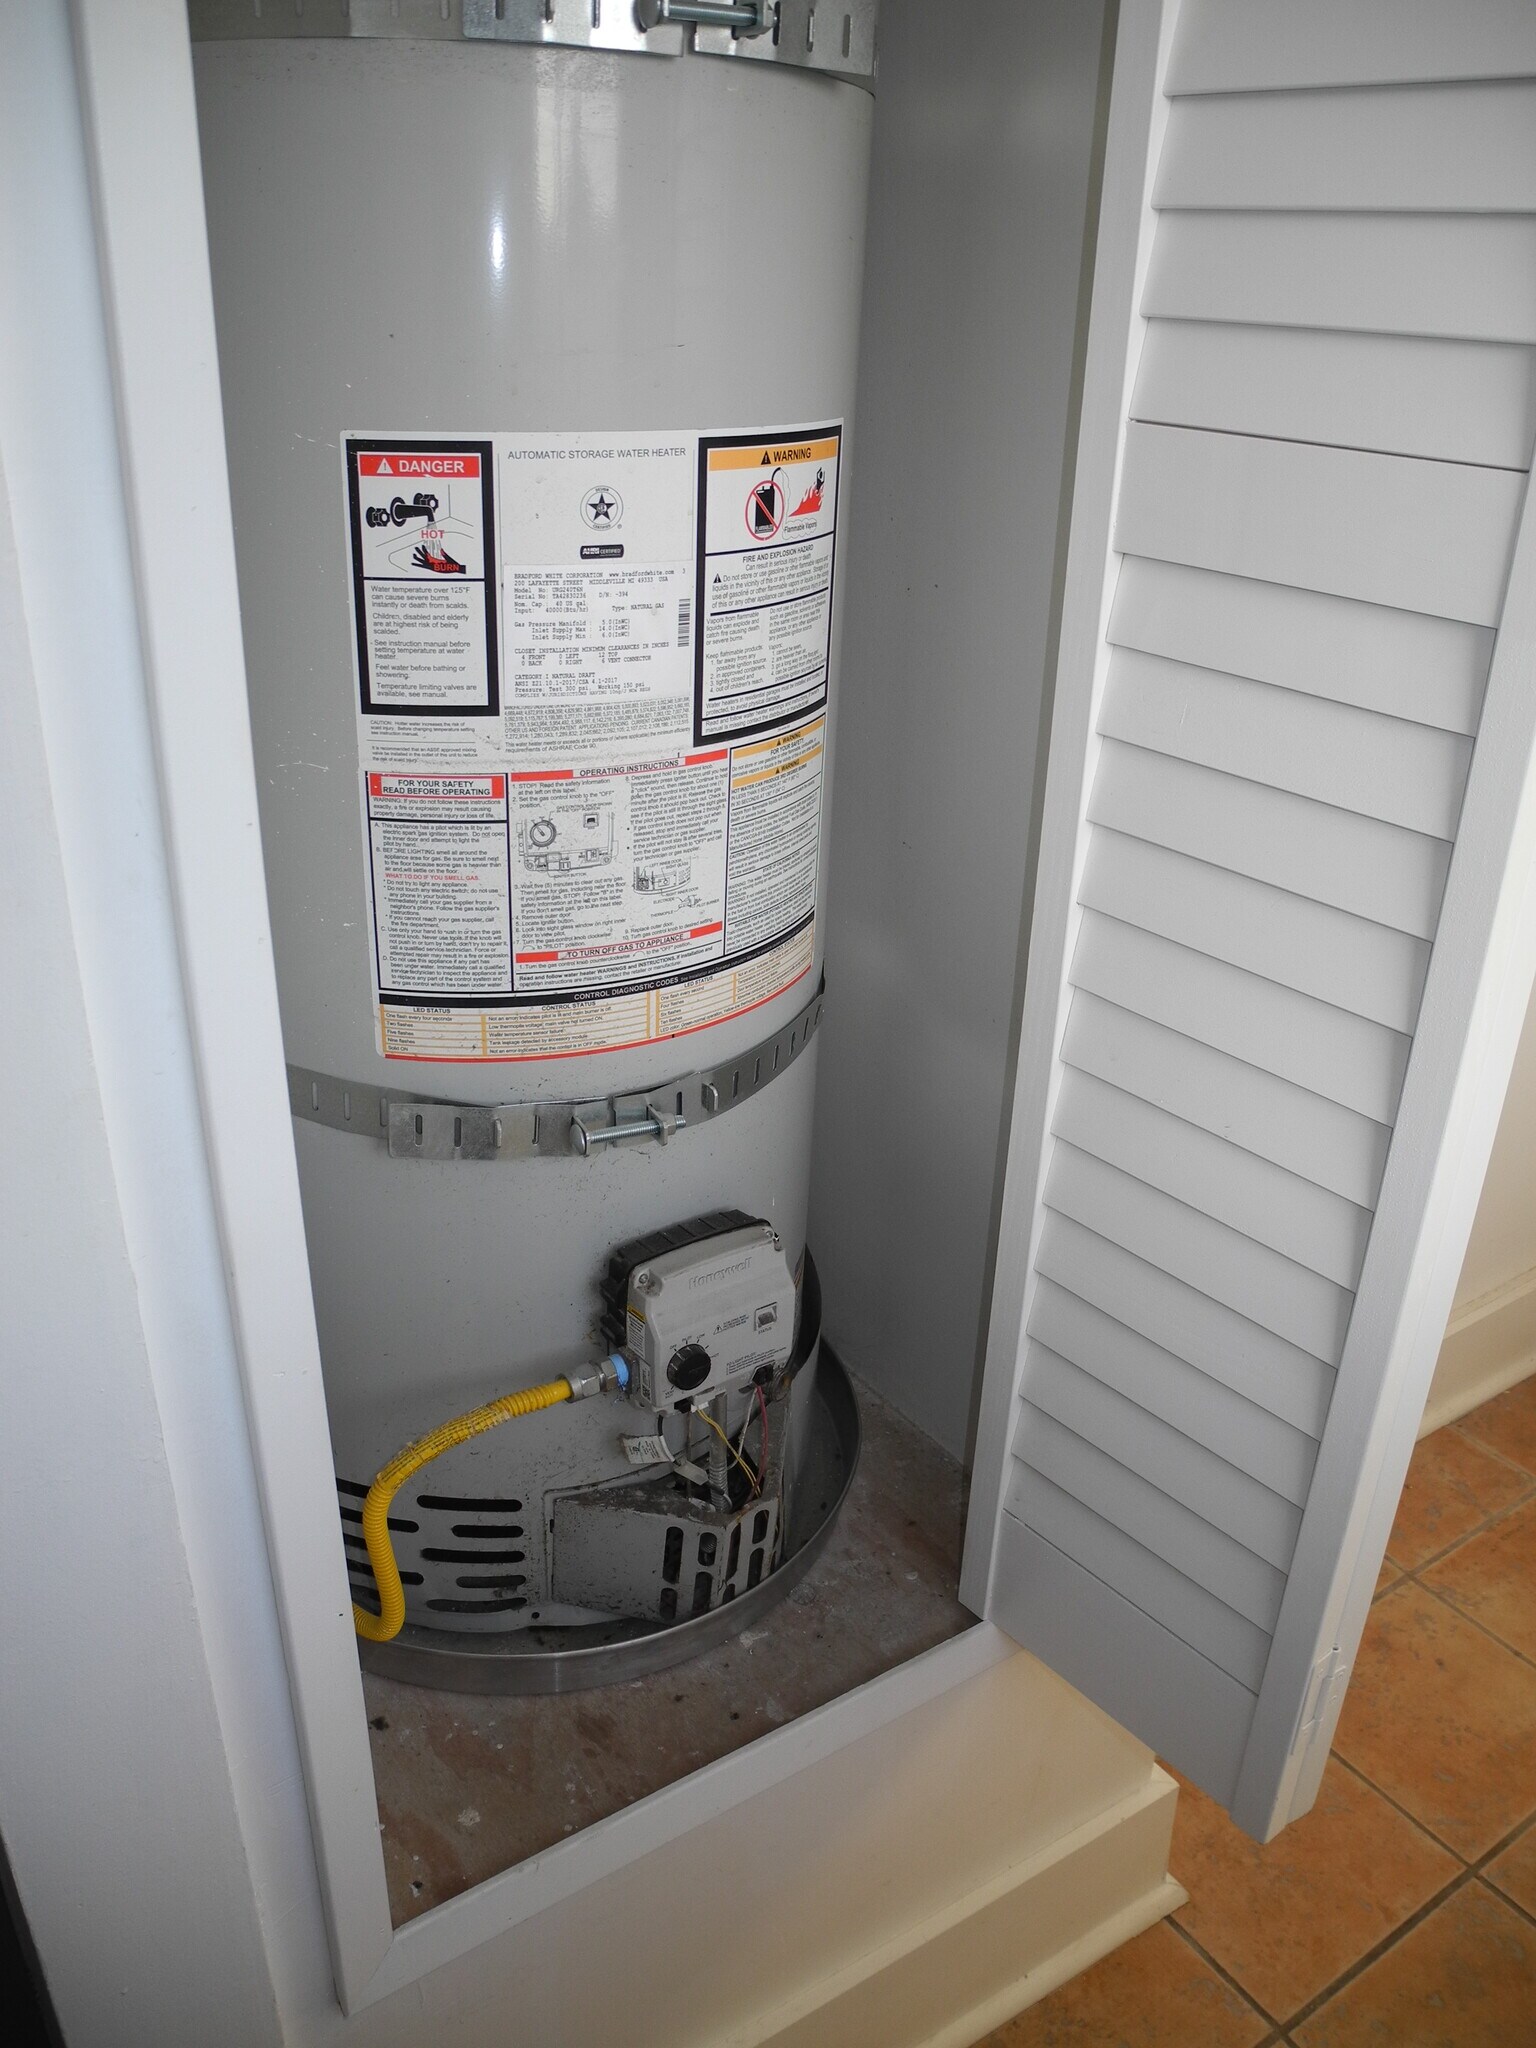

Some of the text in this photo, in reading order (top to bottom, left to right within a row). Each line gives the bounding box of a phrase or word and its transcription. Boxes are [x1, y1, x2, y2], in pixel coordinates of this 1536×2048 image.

[508, 448, 686, 459] AUTOMATIC STORAGE WATER HEATER
[774, 448, 812, 462] WARNING
[400, 460, 464, 472] DANGER
[784, 521, 817, 532] Flammable Vapors
[421, 530, 444, 538] HOT
[770, 549, 796, 560] EXPLOSION
[798, 544, 813, 553] HAZARD
[580, 760, 679, 776] OPERATING INSTRUCTIONS
[647, 934, 684, 947] APPLIANCE
[695, 976, 713, 985] STATUS
[574, 977, 678, 1000] CONTROL DIAGNOSTIC CODES
[689, 1256, 752, 1289] Honeywell
